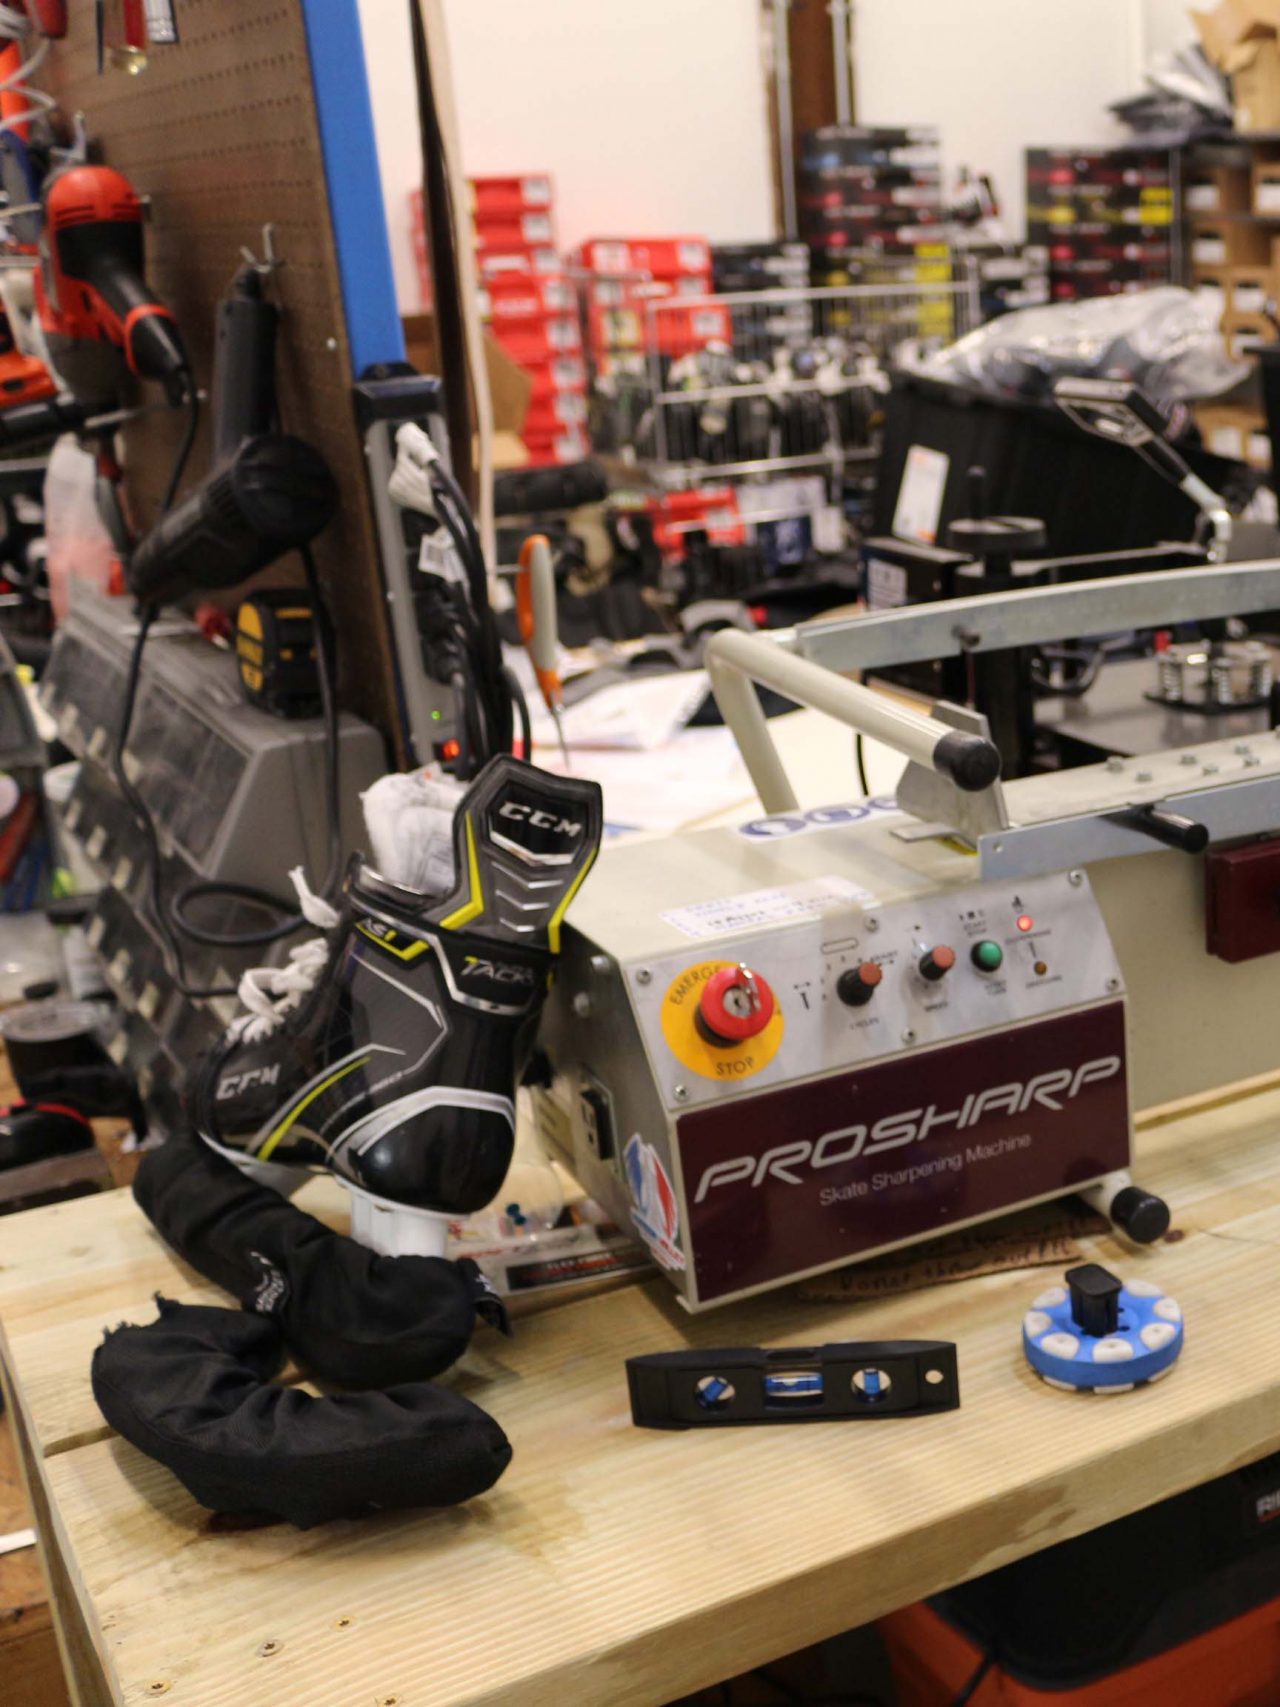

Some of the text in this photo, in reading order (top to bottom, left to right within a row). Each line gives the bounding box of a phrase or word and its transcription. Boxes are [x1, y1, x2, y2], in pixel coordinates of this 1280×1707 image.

[499, 801, 582, 838] CCM
[715, 1056, 755, 1076] STOP
[694, 1055, 1121, 1203] PROSHARP
[819, 1132, 1032, 1206] Skate Sharpening Machine
